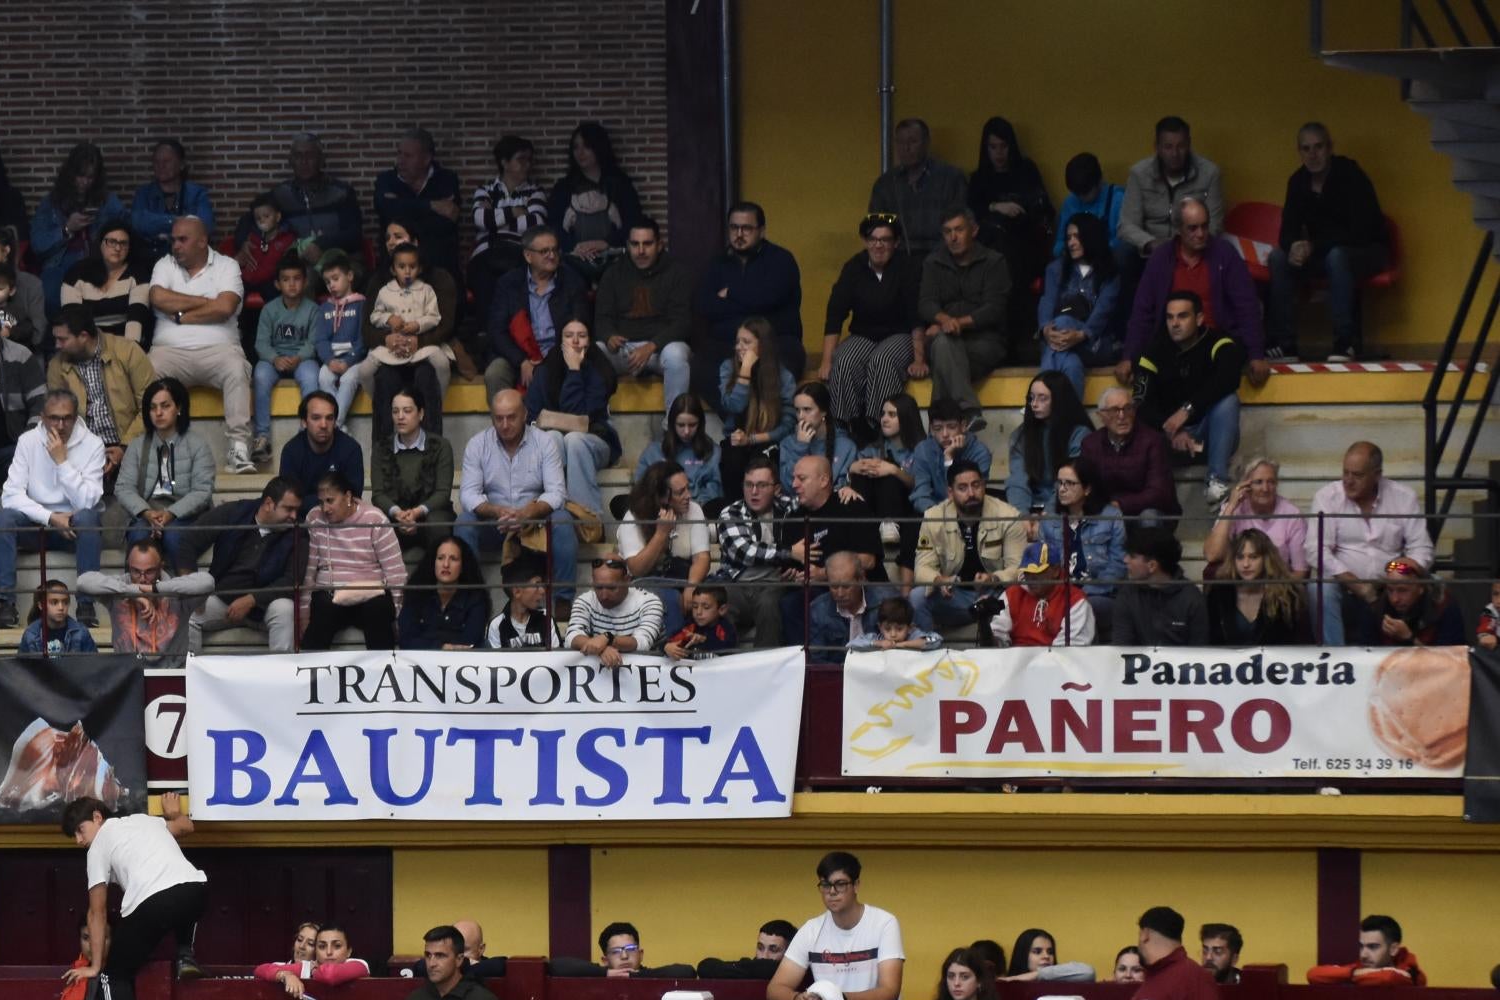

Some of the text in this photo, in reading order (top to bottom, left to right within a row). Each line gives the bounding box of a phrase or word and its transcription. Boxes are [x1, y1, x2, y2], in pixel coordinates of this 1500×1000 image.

[296, 663, 698, 705] TRANSPORTES
[1121, 653, 1357, 687] Panadería
[156, 702, 187, 753] 7
[938, 681, 1293, 754] PAÑERO
[205, 725, 788, 807] BAUTISTA
[1292, 758, 1414, 770] Telf. 625 34 39 16
